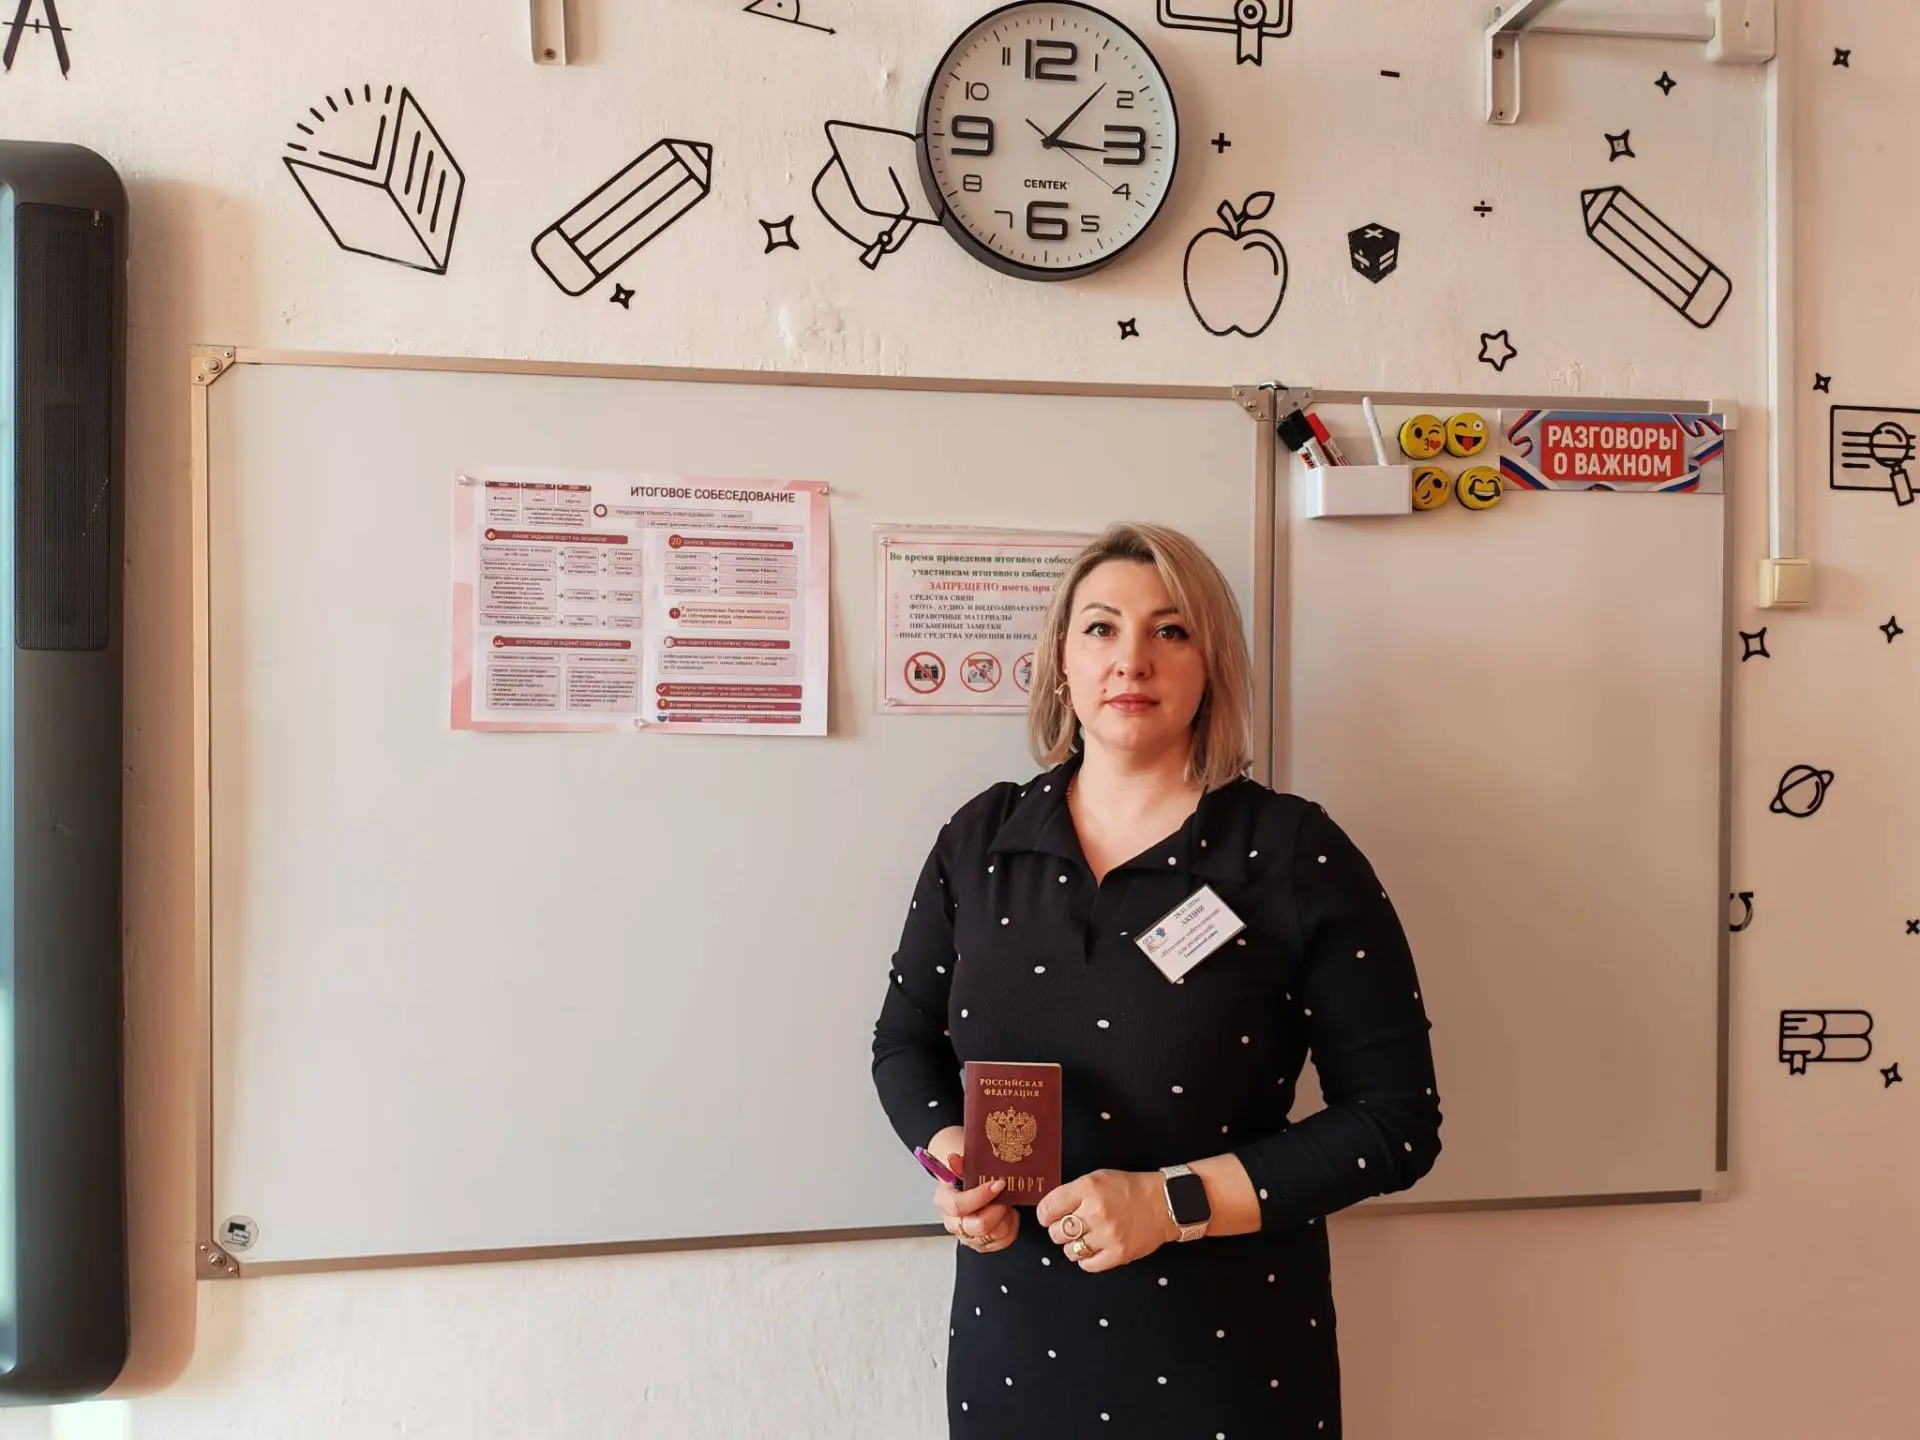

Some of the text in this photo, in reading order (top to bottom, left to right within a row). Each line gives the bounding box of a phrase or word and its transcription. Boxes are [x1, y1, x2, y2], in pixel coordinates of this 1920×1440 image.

[1025, 39, 1078, 82] 12
[965, 81, 990, 101] 10
[1116, 90, 1135, 109] 2
[951, 115, 995, 157] 9
[1103, 124, 1146, 166] 3
[963, 174, 982, 193] 8
[1024, 178, 1068, 191] CENTEK
[1112, 183, 1132, 201] 4
[994, 209, 1014, 229] 7
[1026, 200, 1069, 241] 6
[1080, 214, 1100, 233] 5
[1547, 425, 1678, 451] РАЗГОВОРЫ
[1553, 453, 1672, 477] О ВАЖНОМ
[630, 485, 796, 503] ИТОГОВОЕ СОБЕСЕДОВАНИЕ
[671, 536, 682, 545] 20
[889, 551, 902, 562] Во
[904, 553, 935, 565] время
[936, 554, 993, 566] проведения
[994, 555, 1042, 565] итогового
[912, 568, 970, 579] участникам
[972, 569, 1020, 579] итогового
[928, 581, 999, 593] ЗАПРЕЩЕНО
[1001, 584, 1030, 593] иметь
[1032, 584, 1051, 595] при
[909, 594, 975, 602] СРЕДСТВА СВЯЗИ
[909, 613, 1012, 621] СПРАВОЧНЫЕ МАТЕРИАЛЫ
[909, 622, 1002, 631] ПИСЬМЕННЫЕ ЗАМЕТКИ
[923, 632, 963, 640] СРЕДСТВА
[980, 1078, 1044, 1088] РОССИЙСКАЯ
[984, 1089, 1040, 1098] ФЕДЕРАЦИЯ
[979, 1174, 1045, 1192] ППОРТ
